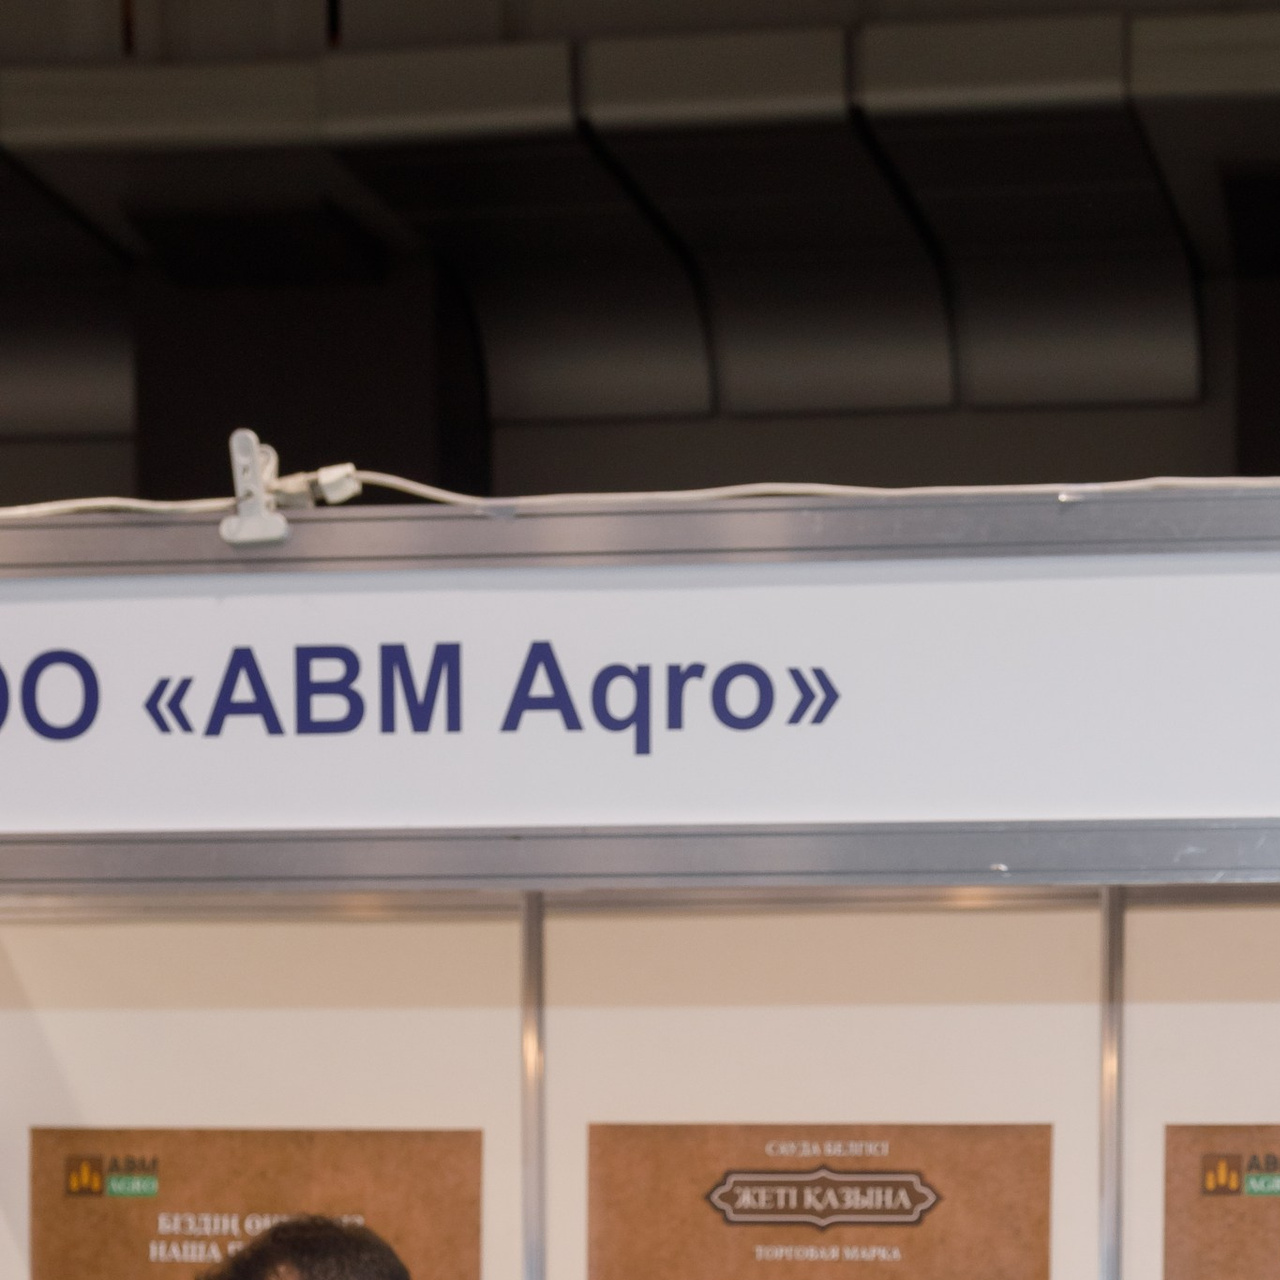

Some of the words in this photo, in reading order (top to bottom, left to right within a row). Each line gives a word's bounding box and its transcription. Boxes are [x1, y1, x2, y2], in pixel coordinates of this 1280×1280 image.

[0, 648, 100, 742] O
[143, 642, 463, 738] «ABM
[500, 640, 842, 756] Aqro»
